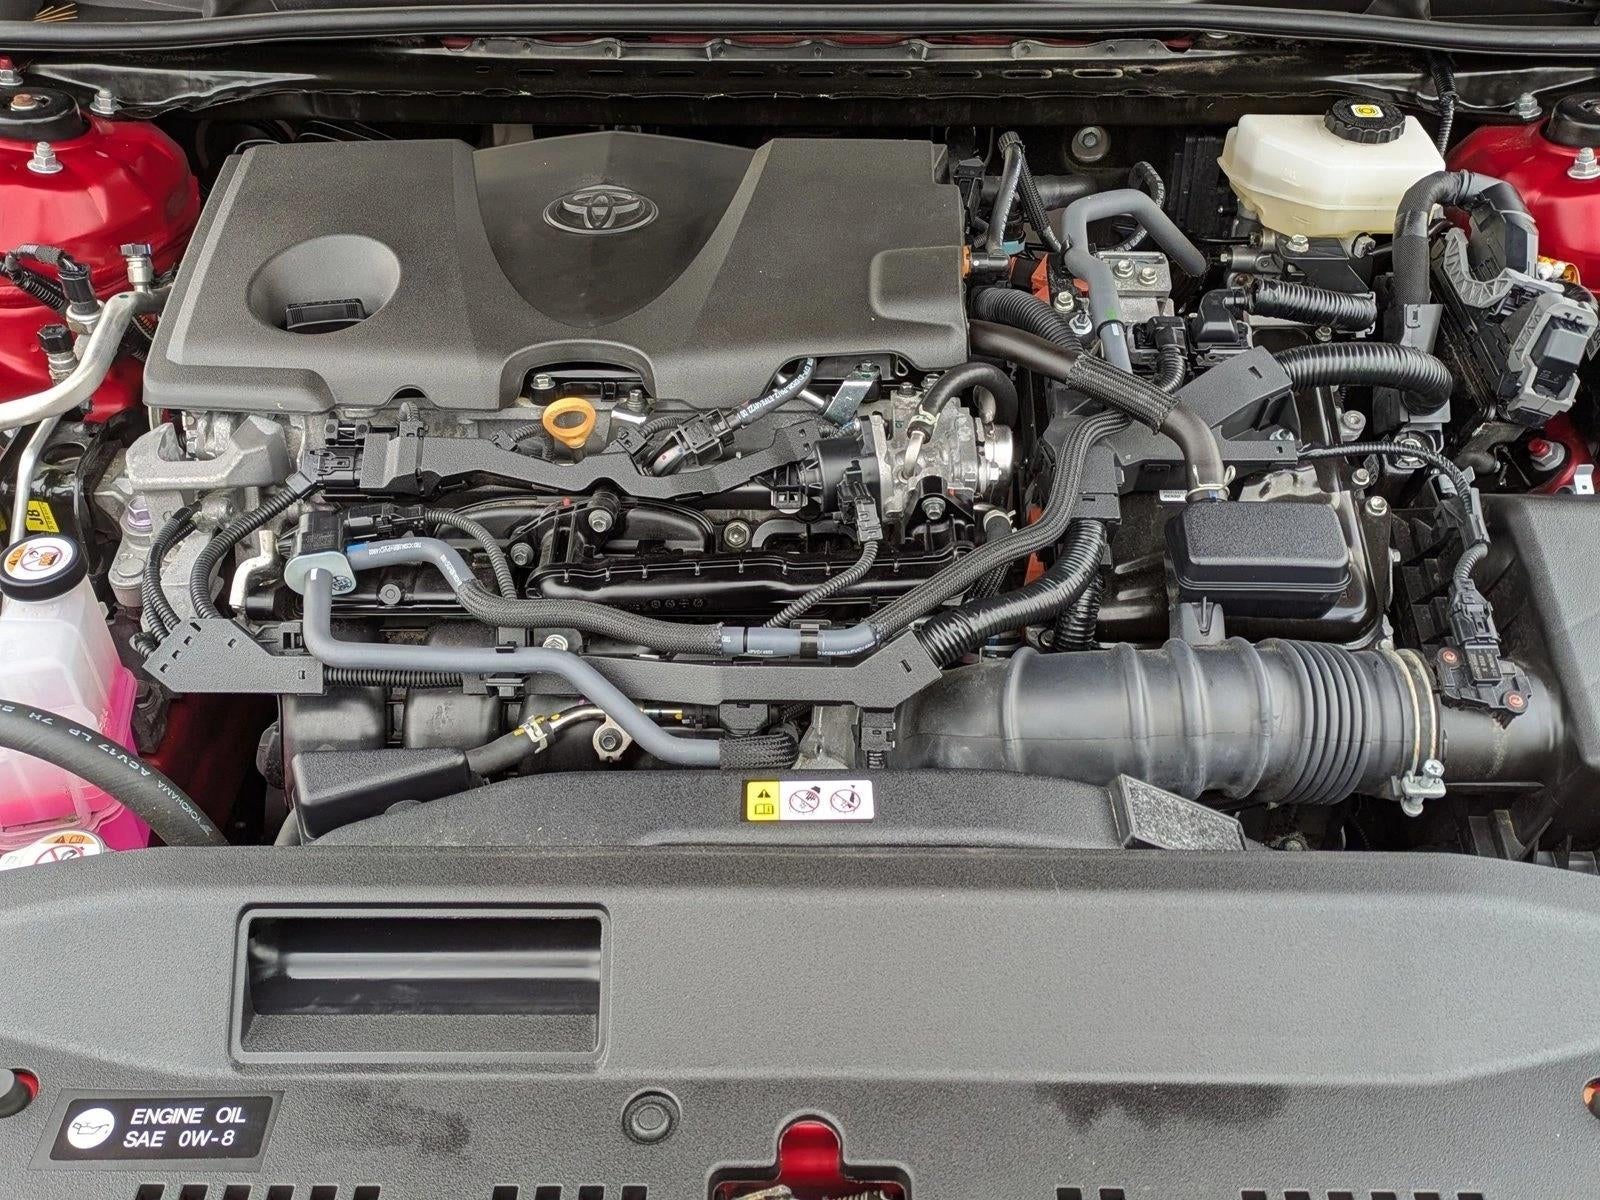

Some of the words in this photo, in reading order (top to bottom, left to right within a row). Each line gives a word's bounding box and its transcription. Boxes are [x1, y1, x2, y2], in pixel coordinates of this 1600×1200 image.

[29, 712, 54, 725] 7H
[68, 727, 93, 742] LP
[98, 743, 150, 777] ACV17
[157, 779, 202, 825] YOKOHAMA
[130, 1107, 204, 1124] ENGINE
[215, 1107, 246, 1123] OIL
[123, 1130, 166, 1147] SAE
[178, 1130, 235, 1147] 0W-8
